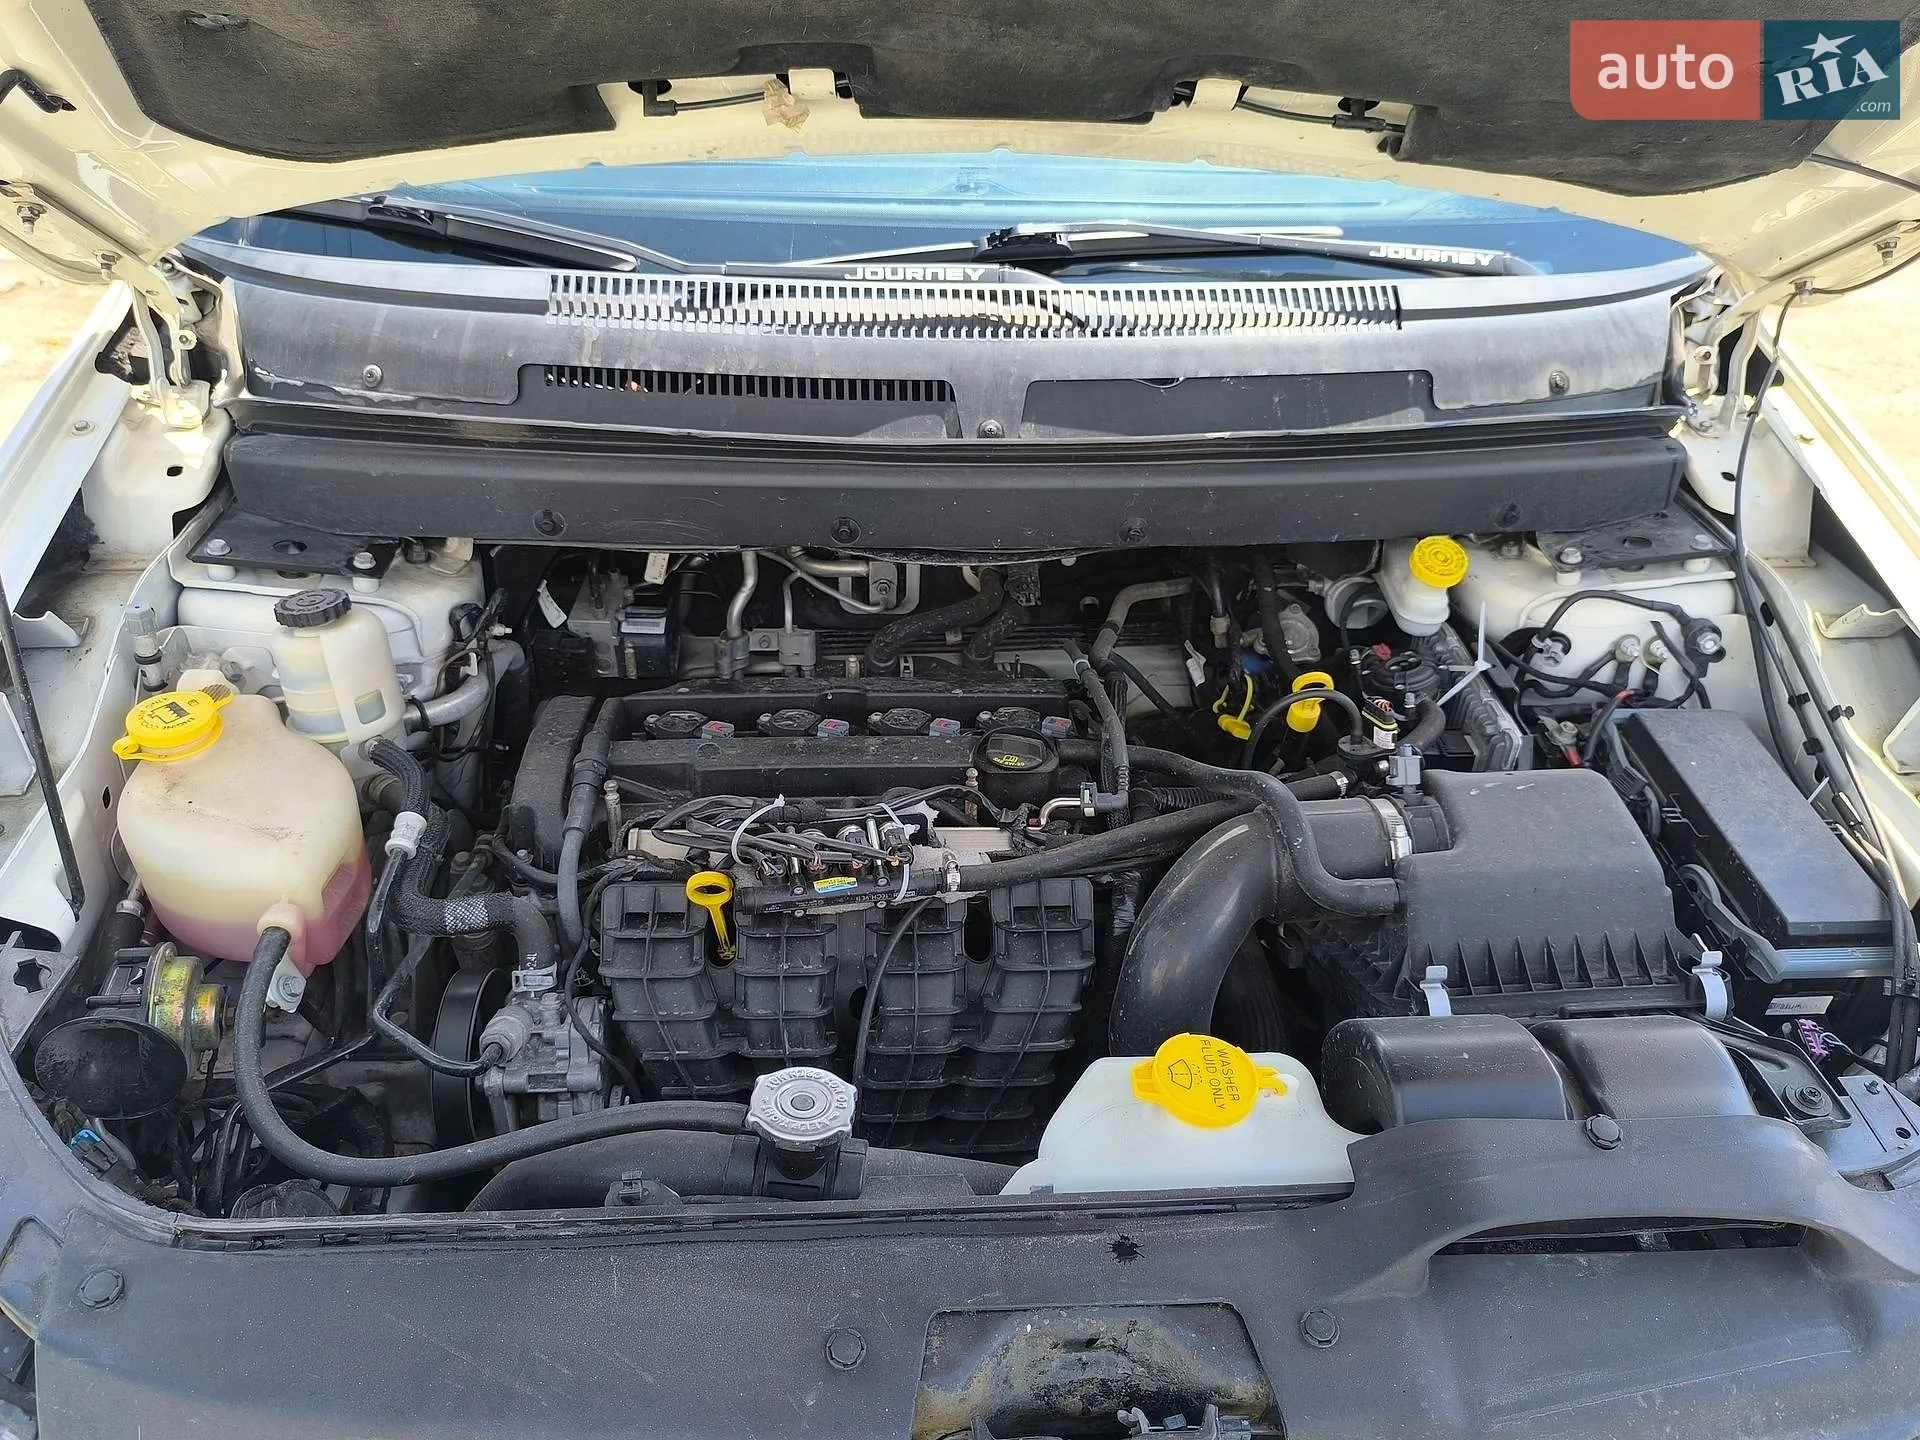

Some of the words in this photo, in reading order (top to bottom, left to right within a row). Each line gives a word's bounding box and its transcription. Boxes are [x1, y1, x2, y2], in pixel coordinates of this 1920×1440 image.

[843, 267, 986, 281] JOURNEY
[1368, 246, 1495, 266] JOURNEY
[1200, 1039, 1218, 1074] FLUID
[1209, 1078, 1227, 1110] ONLY
[1217, 1048, 1240, 1102] WASHER
